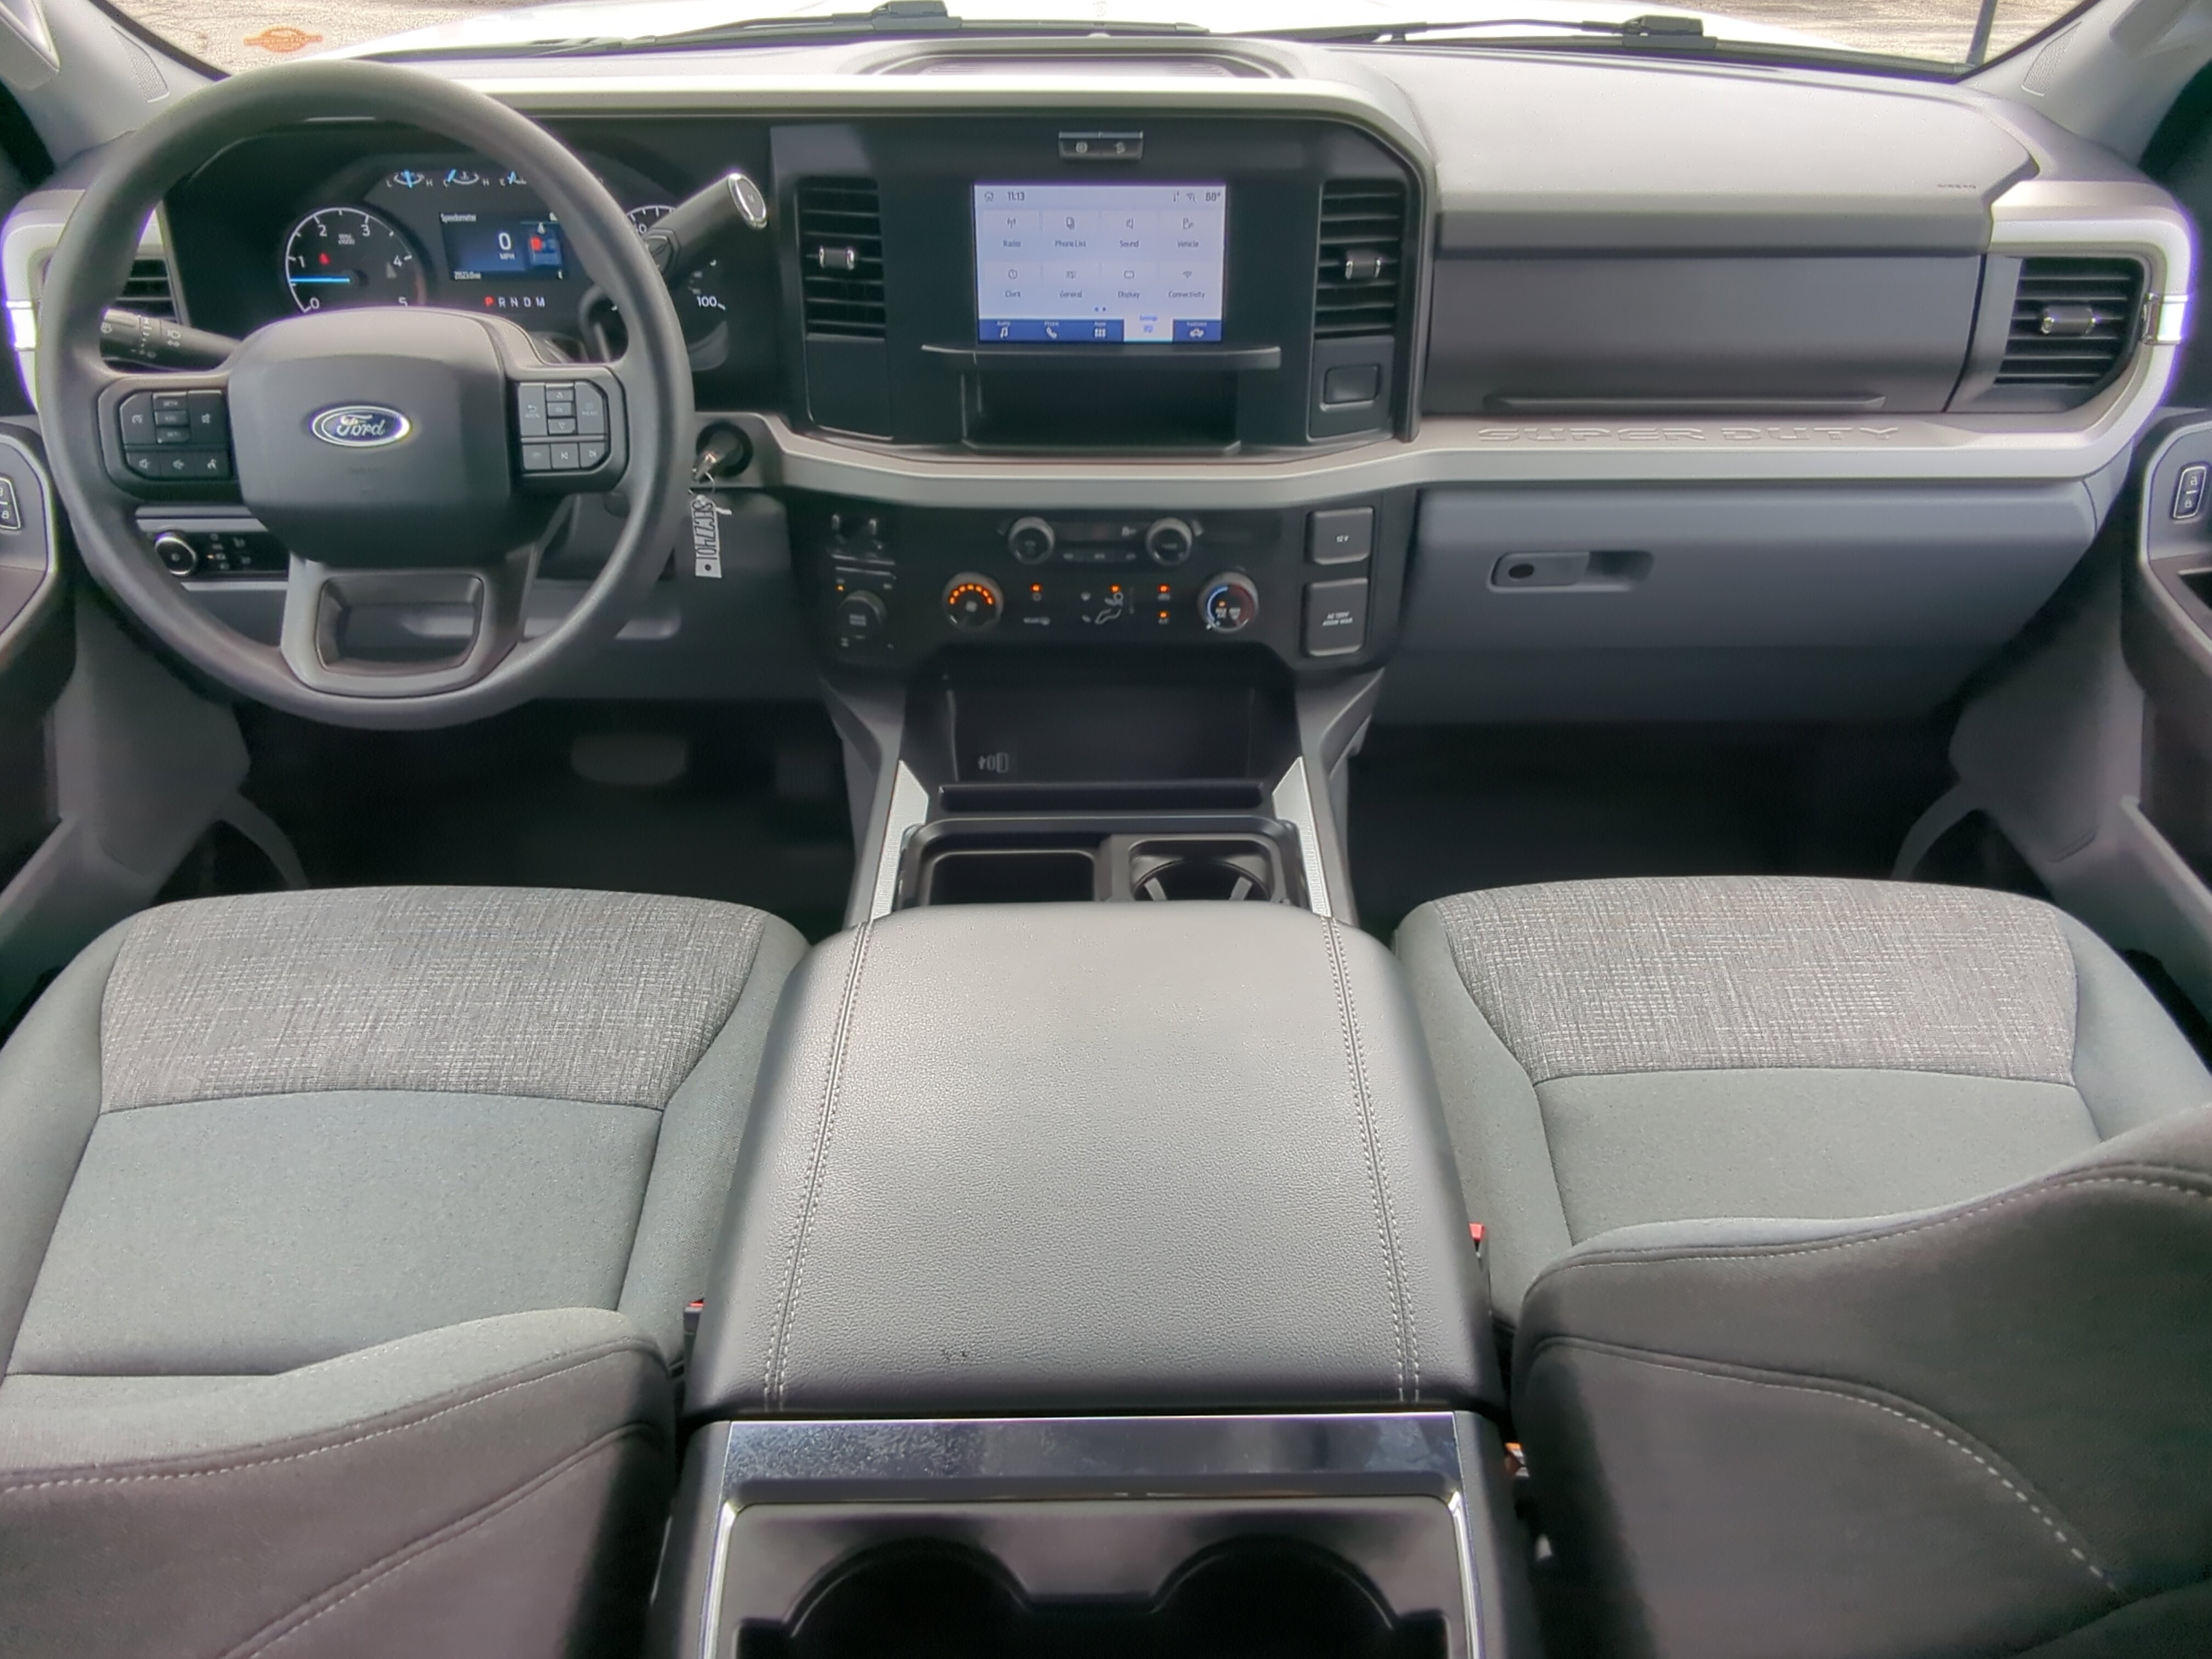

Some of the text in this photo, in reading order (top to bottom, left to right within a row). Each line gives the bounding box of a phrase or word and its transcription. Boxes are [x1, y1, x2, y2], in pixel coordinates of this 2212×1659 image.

[1007, 191, 1025, 201] 11:13
[318, 224, 328, 236] 2
[361, 224, 370, 236] 3
[499, 232, 511, 250] 0
[298, 256, 304, 268] 1
[393, 255, 403, 267] 4
[485, 296, 545, 307] P R N D M
[1168, 291, 1205, 300] Connectivity
[310, 297, 319, 309] 0
[398, 297, 408, 307] 5
[696, 296, 717, 308] 100
[1479, 427, 1898, 441] SUPER DUTY
